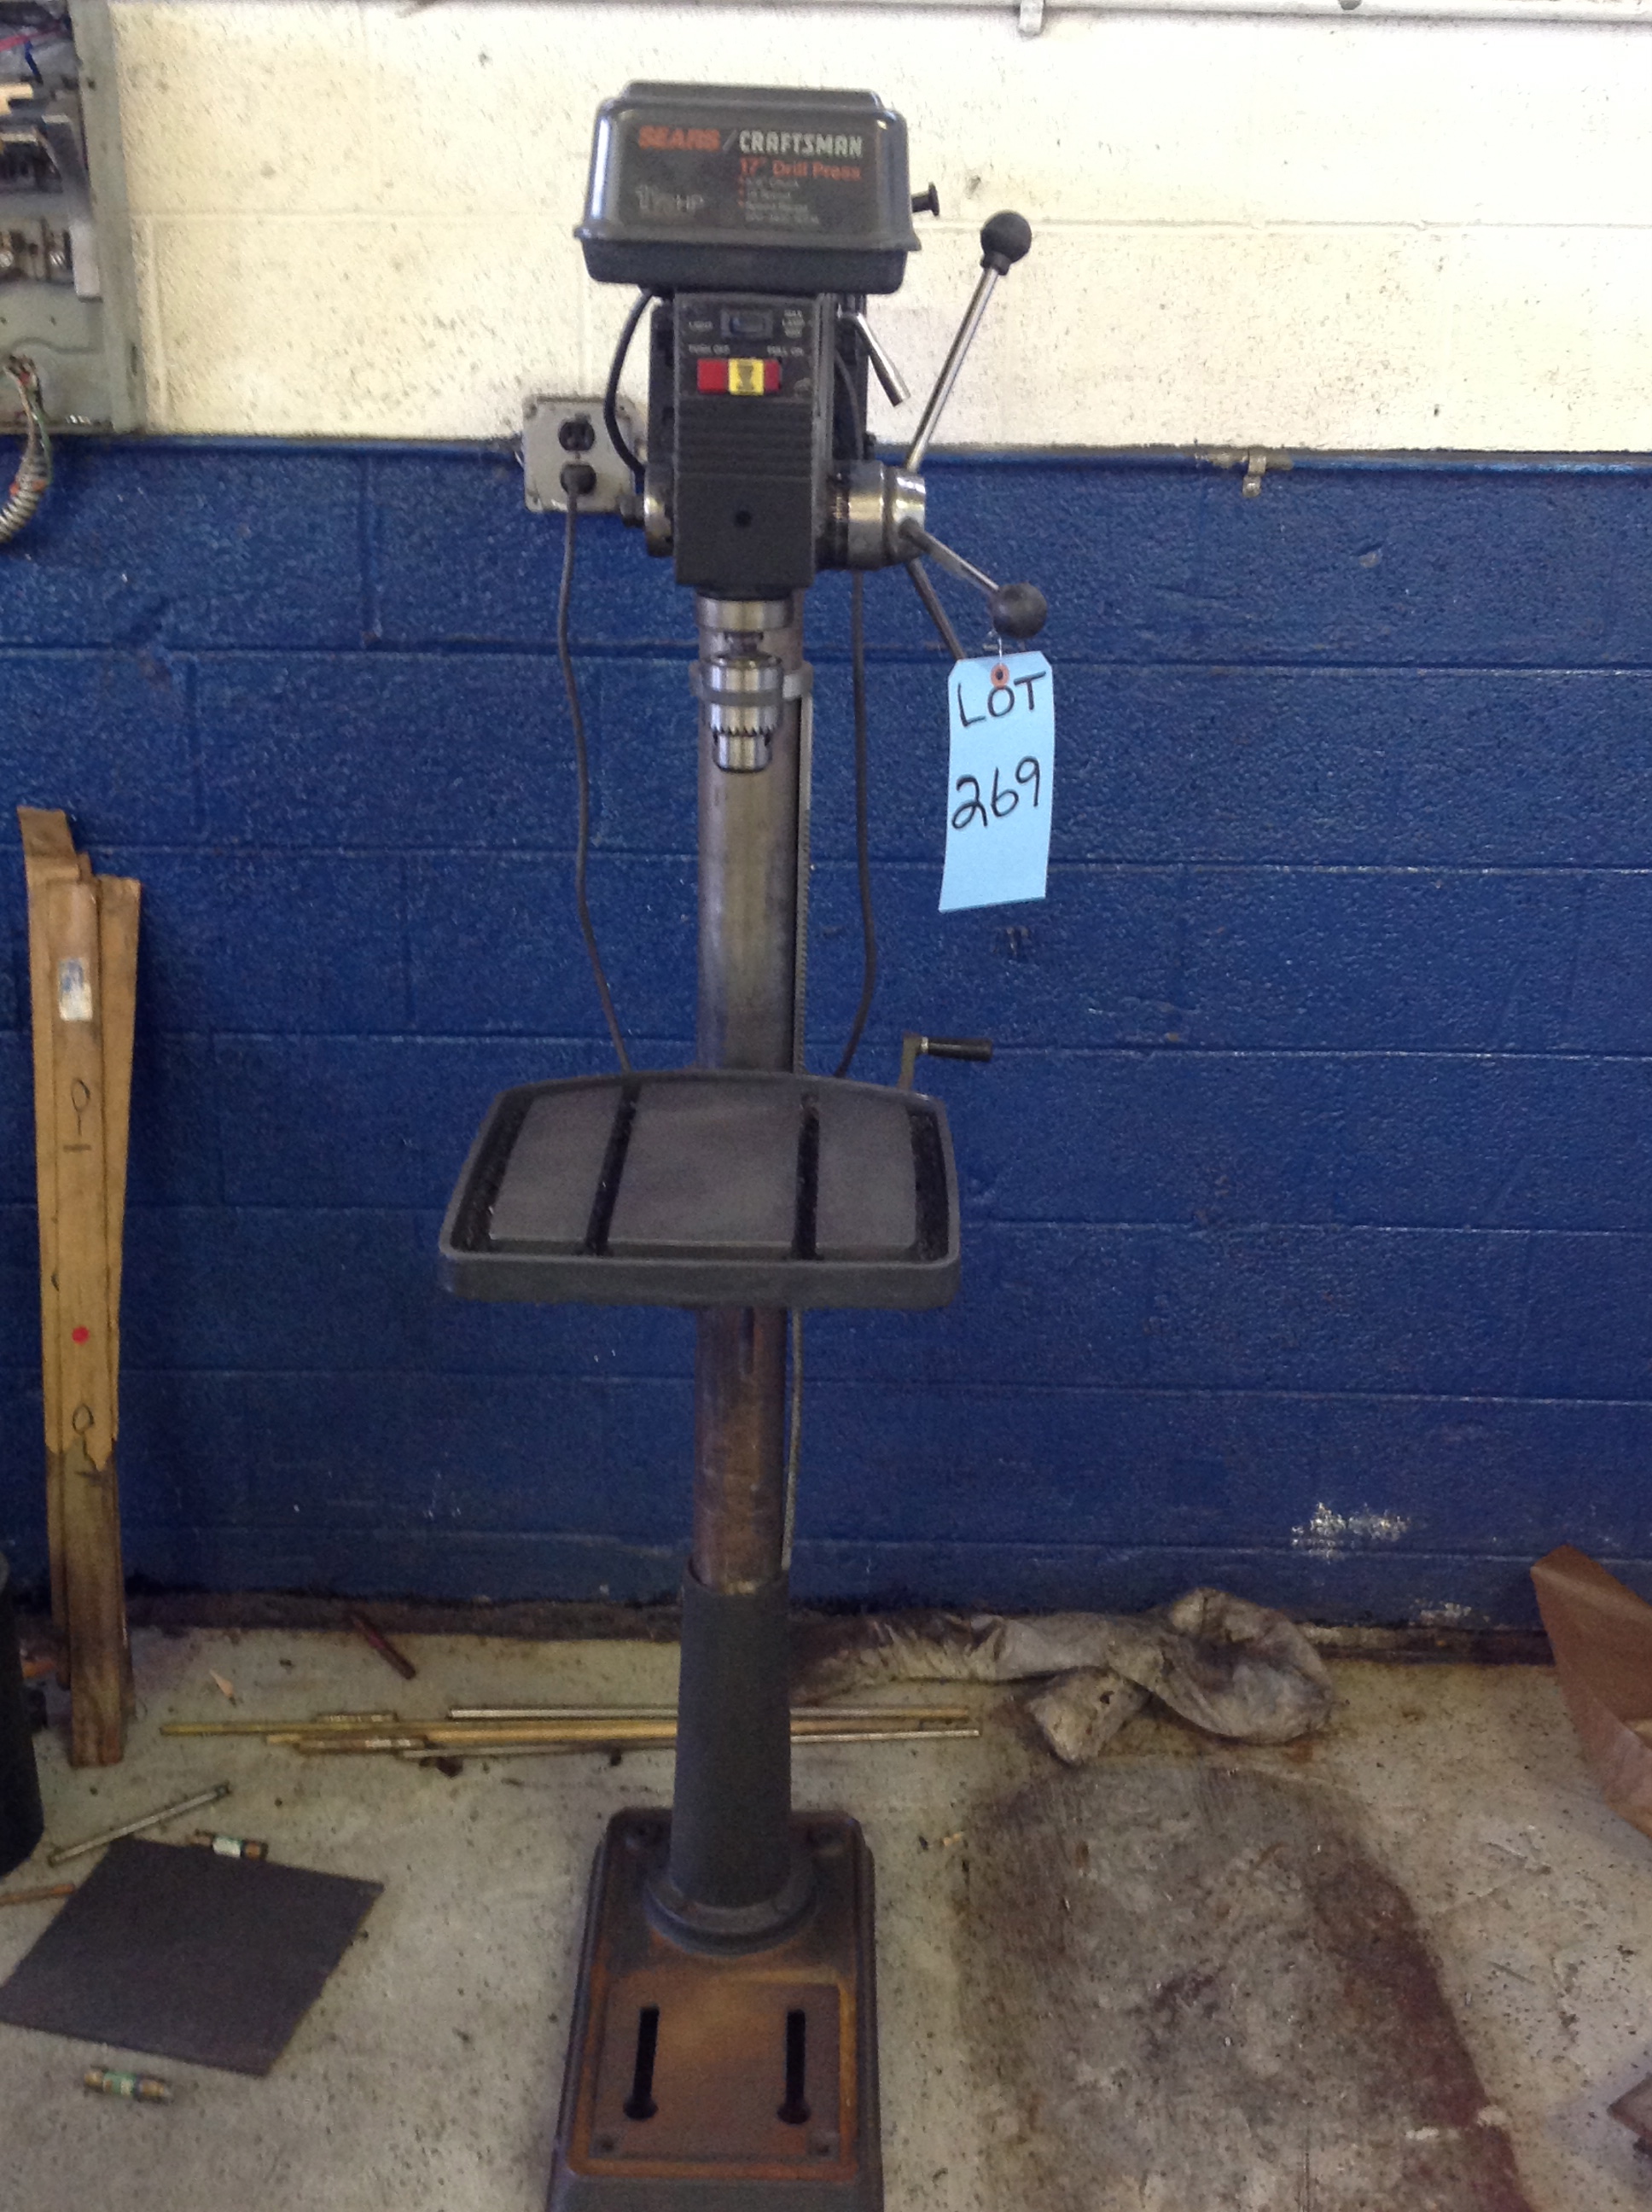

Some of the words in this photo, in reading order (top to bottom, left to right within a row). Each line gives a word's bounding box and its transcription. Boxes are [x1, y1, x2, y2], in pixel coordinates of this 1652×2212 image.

[739, 130, 863, 157] CRAFTSMAN
[957, 671, 1046, 727] LOT
[951, 755, 1040, 830] 269
